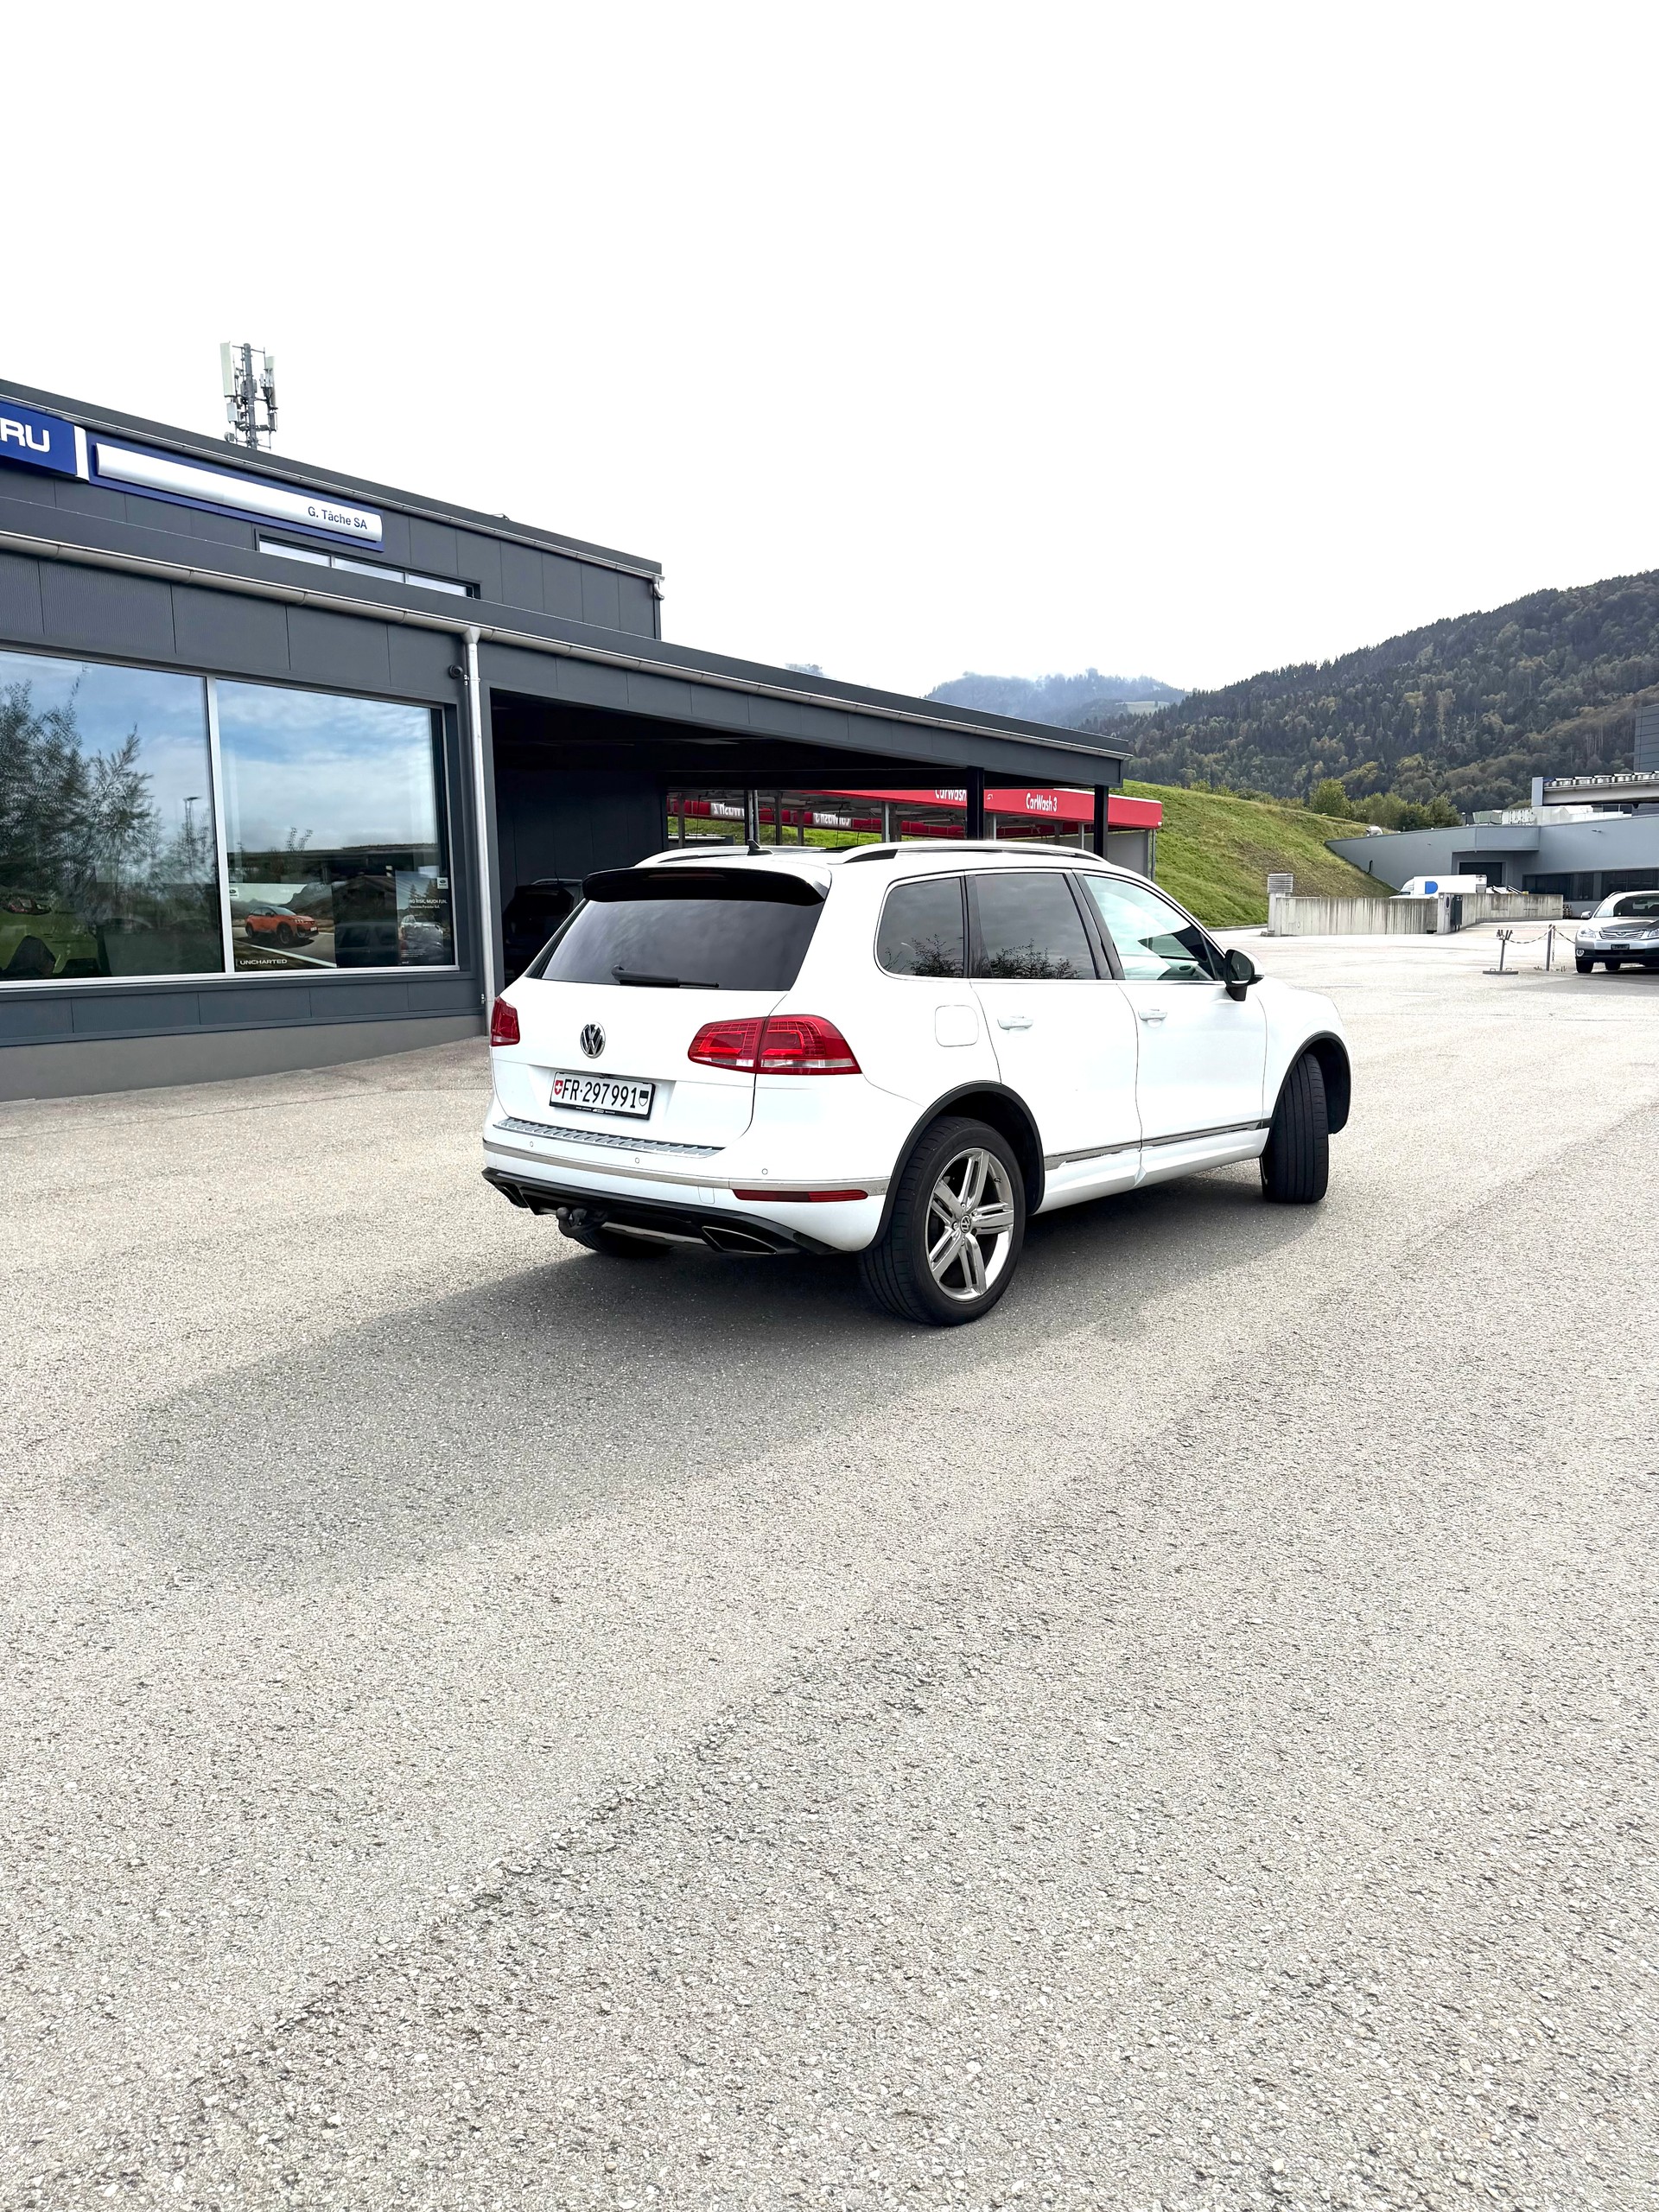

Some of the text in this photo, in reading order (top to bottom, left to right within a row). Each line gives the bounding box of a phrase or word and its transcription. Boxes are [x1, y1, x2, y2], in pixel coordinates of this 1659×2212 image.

[308, 506, 368, 530] G. Tâche SA
[1026, 792, 1058, 812] CarWash 3
